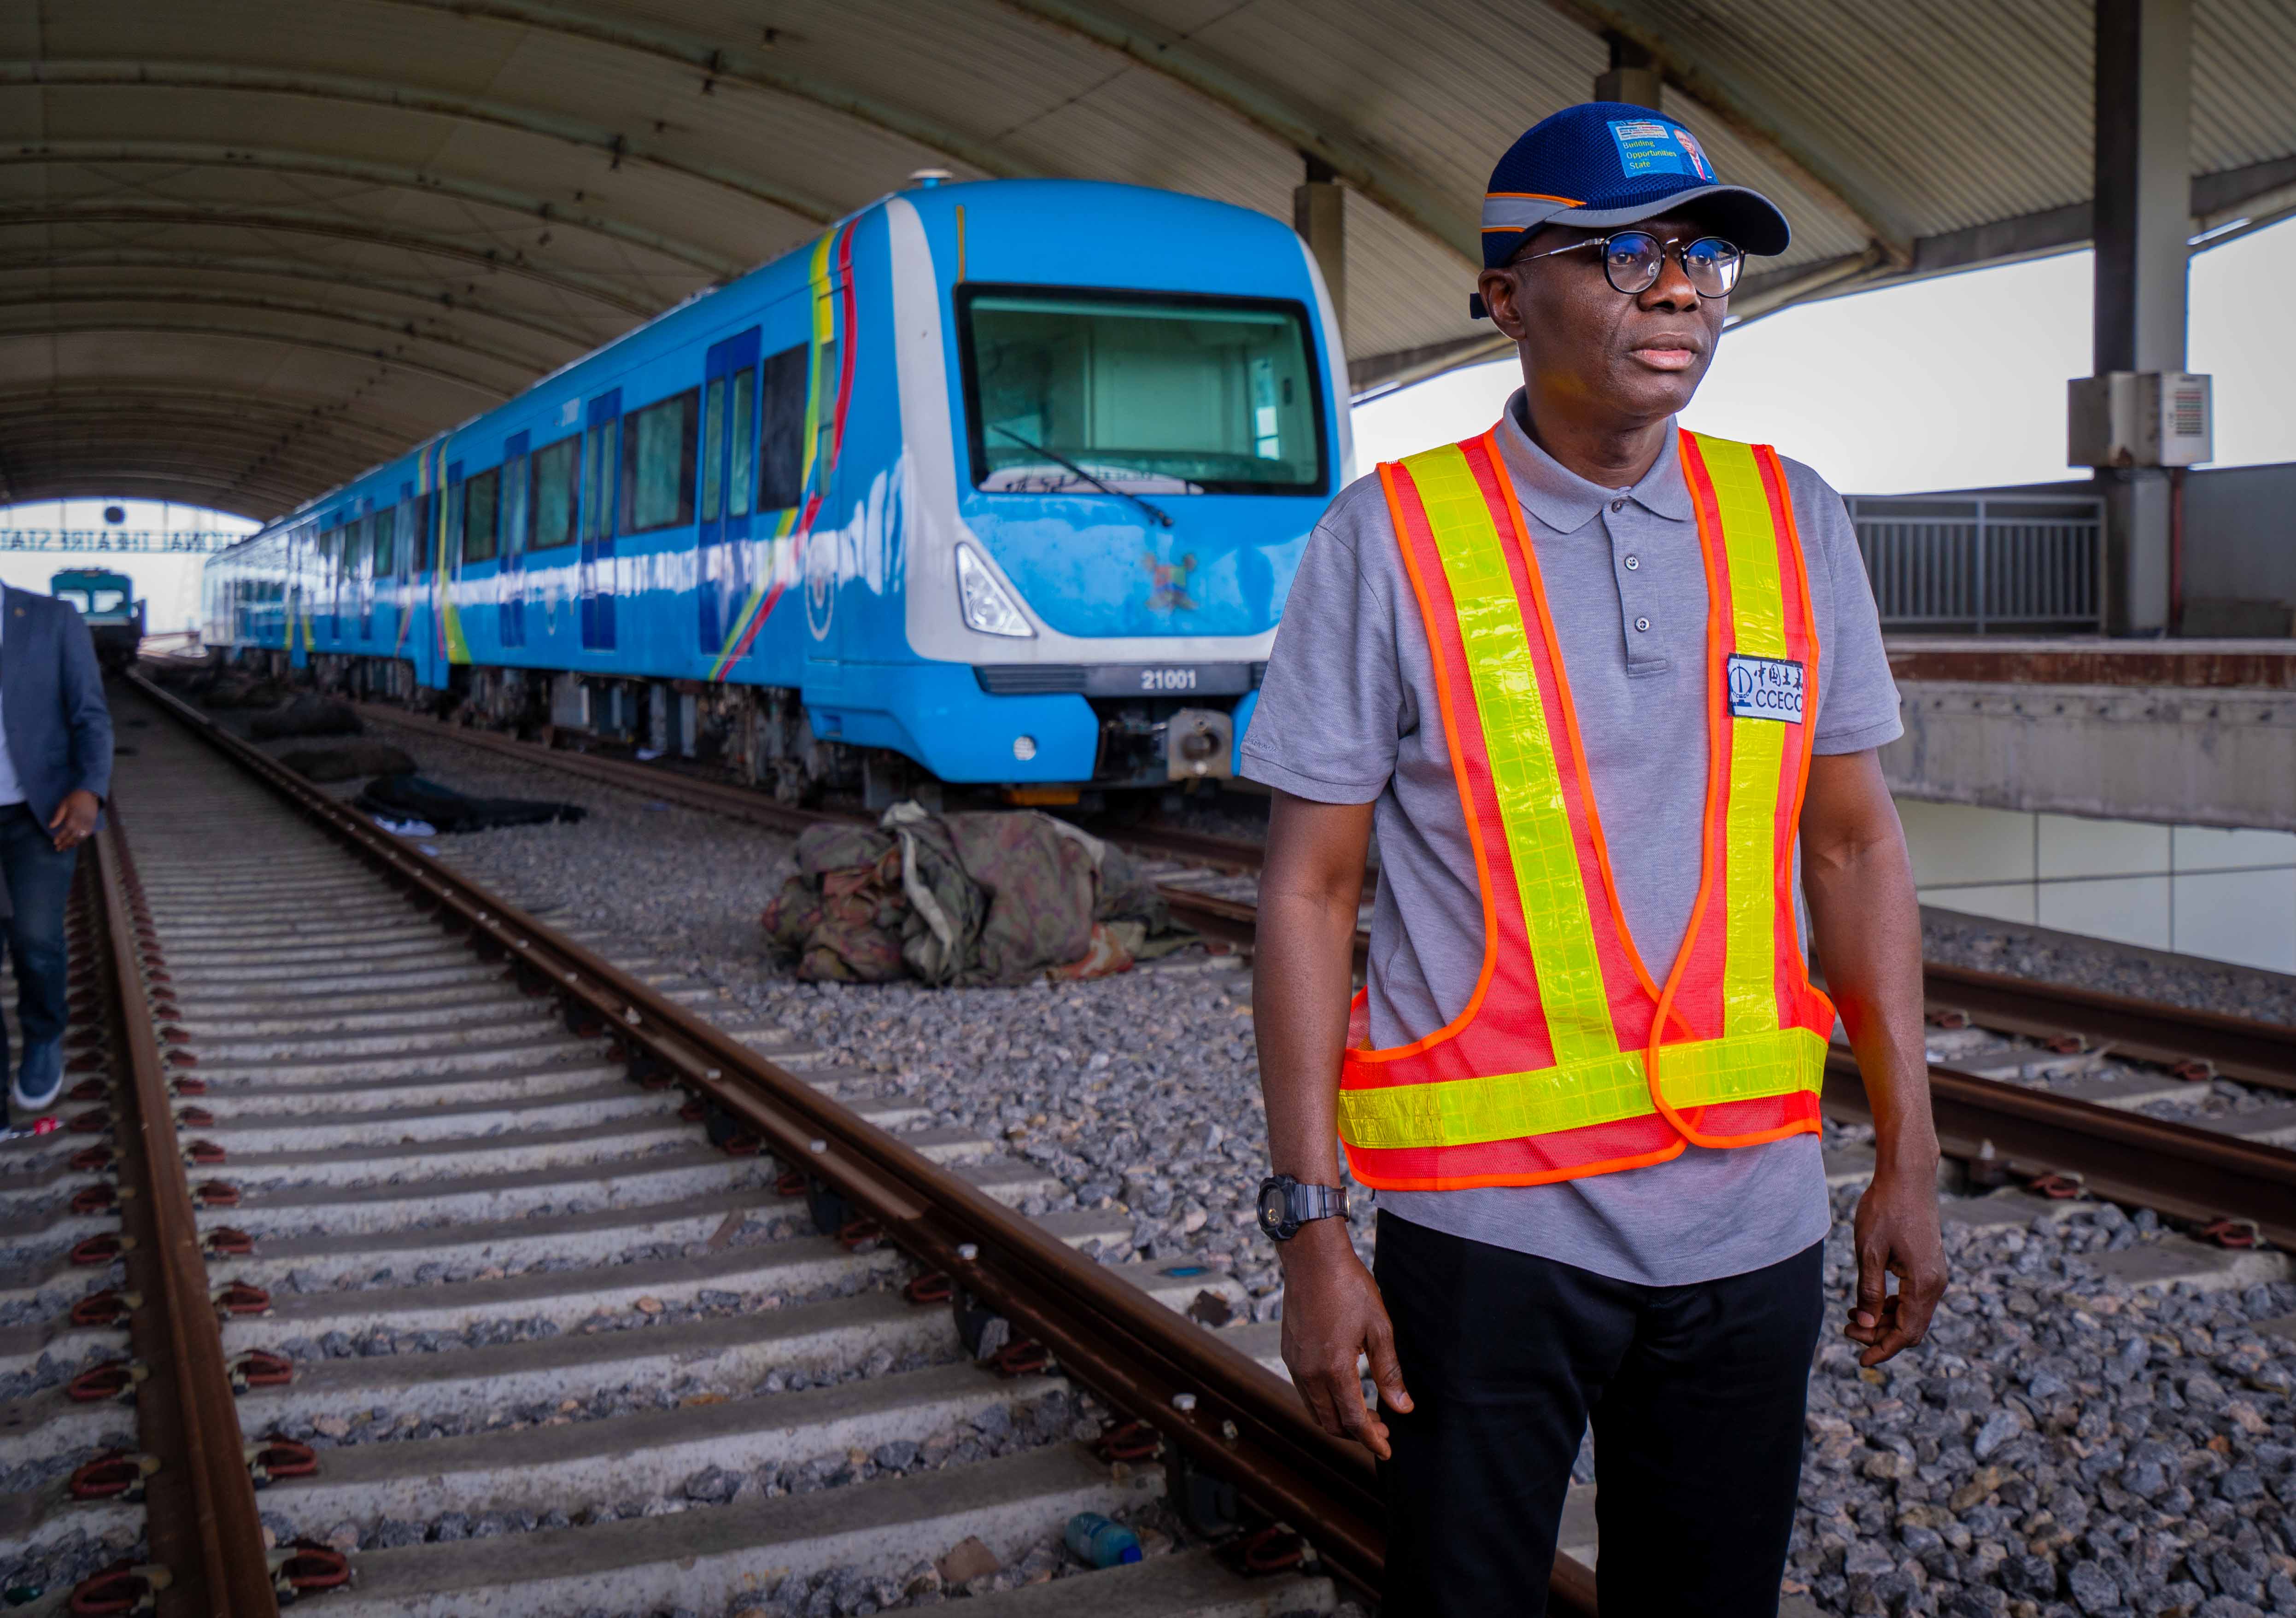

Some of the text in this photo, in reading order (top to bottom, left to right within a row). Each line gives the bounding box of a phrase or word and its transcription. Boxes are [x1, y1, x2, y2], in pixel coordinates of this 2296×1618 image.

[1622, 140, 1655, 149] Building
[1626, 150, 1677, 159] Opportunities
[1629, 161, 1651, 169] State
[1141, 669, 1196, 689] 21001
[1756, 689, 1803, 713] CCECC
